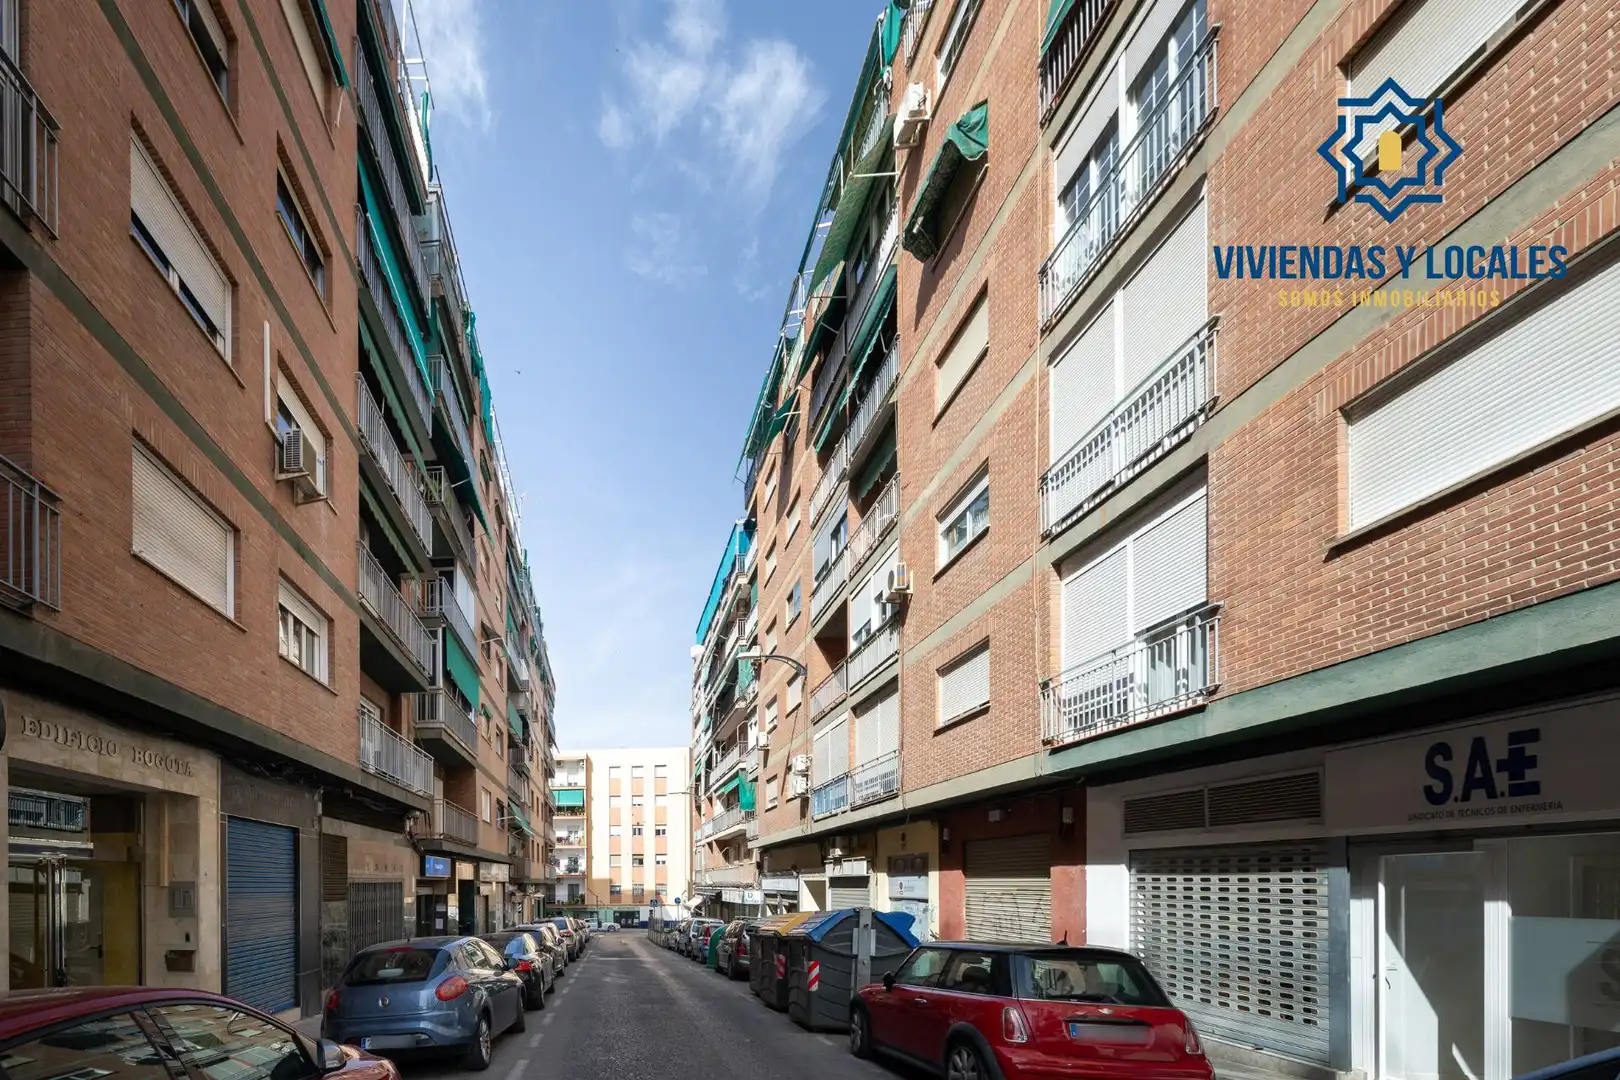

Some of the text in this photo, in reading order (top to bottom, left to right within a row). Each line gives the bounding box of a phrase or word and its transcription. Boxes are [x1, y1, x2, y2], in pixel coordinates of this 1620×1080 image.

[21, 715, 118, 757] EDIFICIO
[1408, 809, 1443, 821] SINDICATO
[1446, 808, 1457, 818] DE
[1497, 805, 1508, 814] DE
